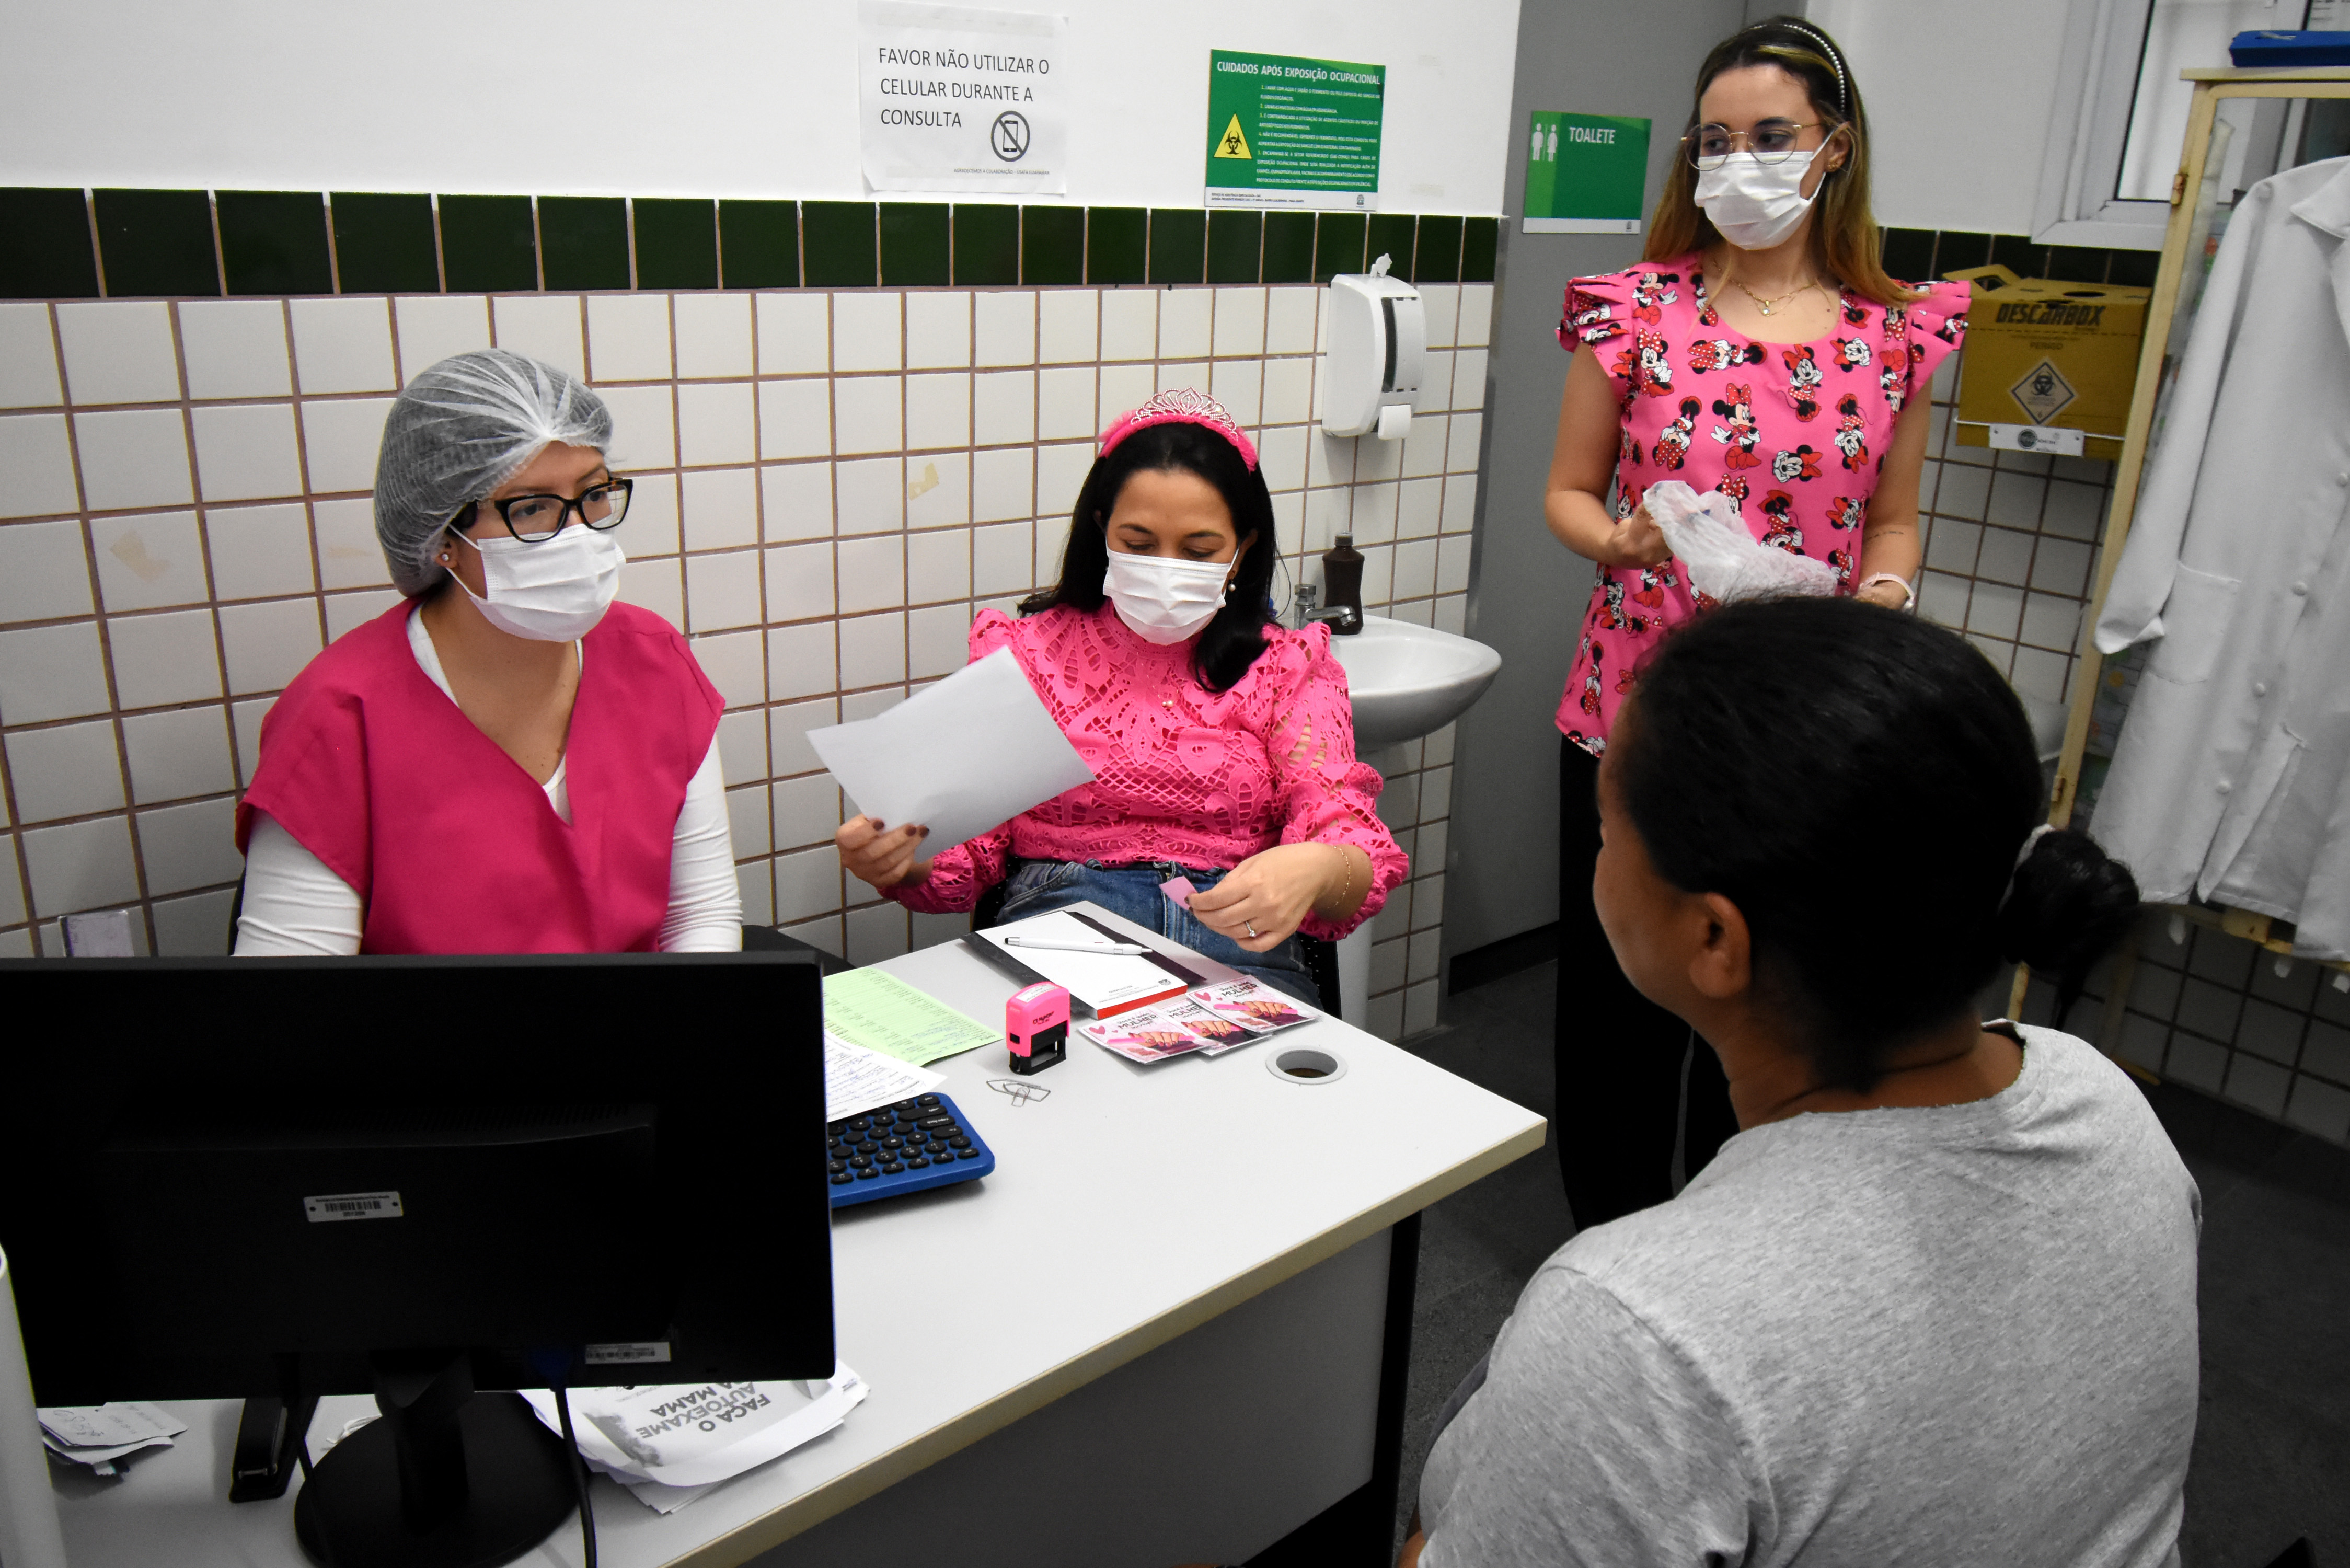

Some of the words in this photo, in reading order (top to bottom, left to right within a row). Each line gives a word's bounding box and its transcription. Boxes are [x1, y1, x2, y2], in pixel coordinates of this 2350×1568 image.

[879, 48, 931, 66] FAVOR
[936, 49, 968, 68] NÃO
[974, 54, 1034, 73] UTILIZAR
[1039, 59, 1049, 74] O
[1217, 61, 1258, 74] CUIDADOS
[1261, 64, 1282, 76] APÓS
[1285, 67, 1327, 82] EXPOSIÇÃO
[1330, 72, 1380, 85] OCUPACIONAL
[880, 78, 947, 97] CELULAR
[952, 83, 1020, 101] DURANTE
[1024, 87, 1033, 102] A
[881, 109, 962, 128] CONSULTA
[1569, 126, 1616, 144] TOALETE
[1222, 983, 1259, 997] MULHER
[1118, 1014, 1158, 1029] MULHER
[636, 1381, 755, 1438] AUTOEXAME
[650, 1386, 717, 1417] MAMA
[715, 1393, 771, 1423] FAÇA
[698, 1420, 716, 1432] O
